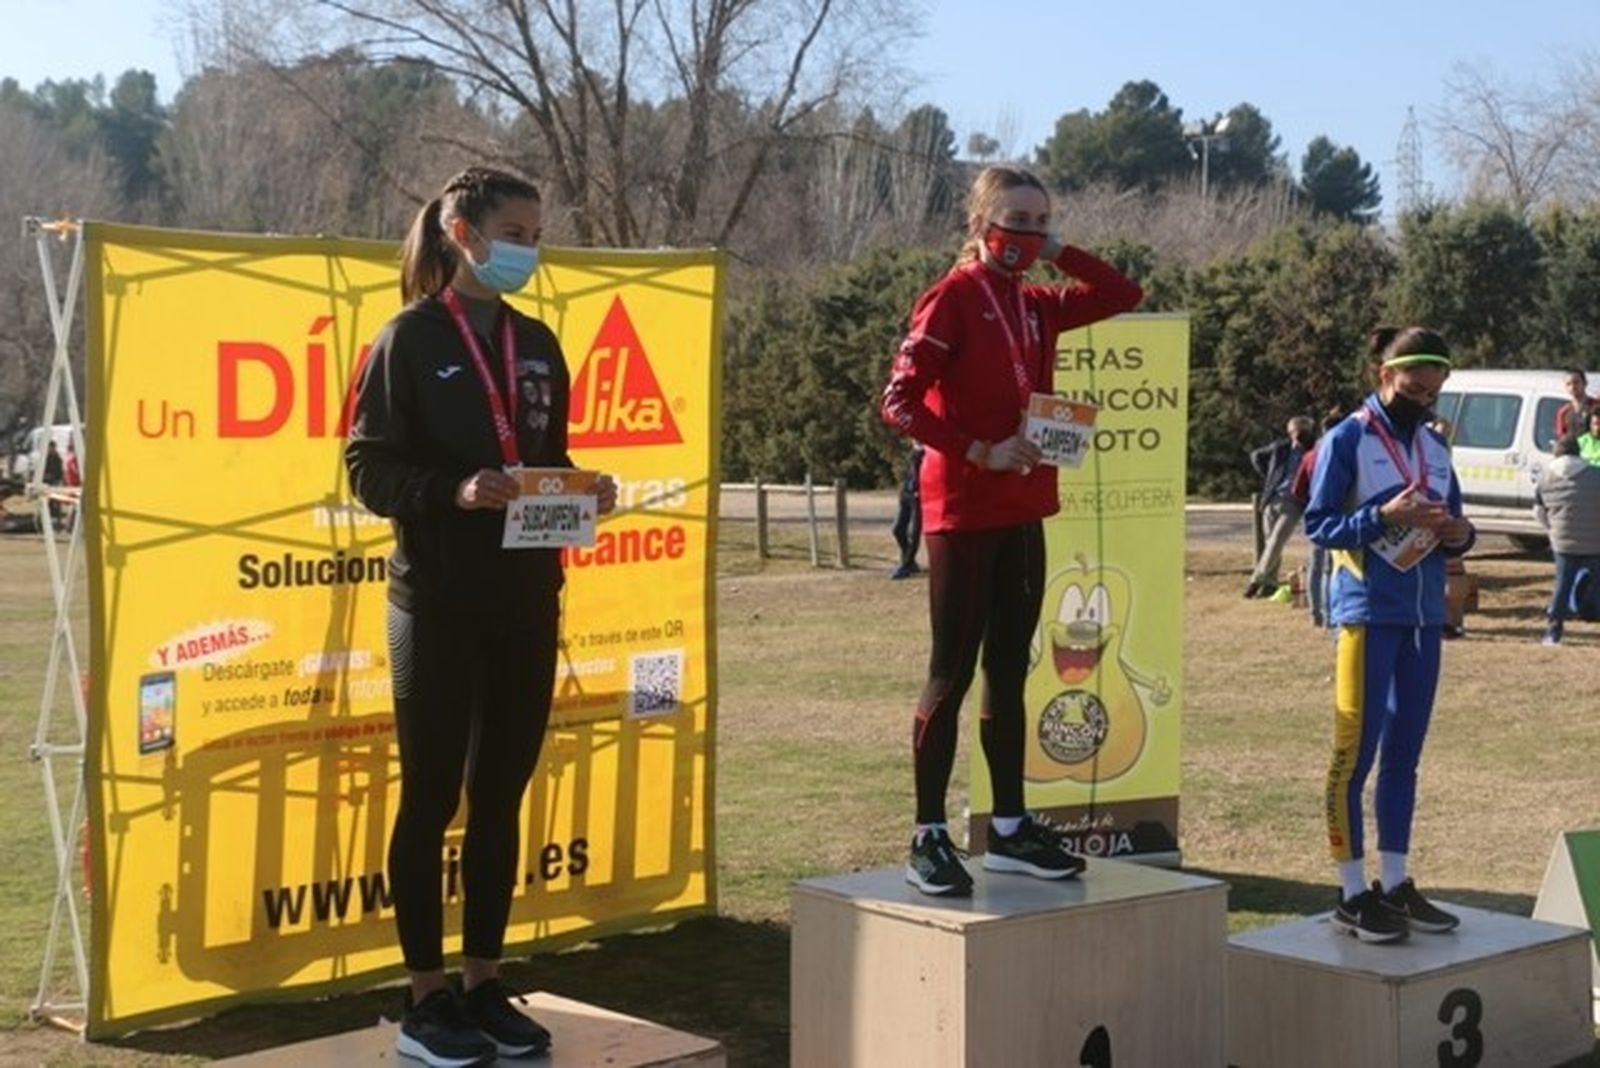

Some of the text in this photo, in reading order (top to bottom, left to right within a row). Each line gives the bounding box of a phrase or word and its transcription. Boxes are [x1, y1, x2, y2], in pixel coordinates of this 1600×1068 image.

[567, 347, 664, 434] Sika
[138, 400, 194, 438] Un
[664, 619, 684, 638] QR
[157, 647, 168, 666] Y
[203, 658, 294, 681] Descárgate
[202, 700, 211, 718] y
[214, 694, 265, 712] accede
[269, 694, 279, 709] a
[284, 684, 322, 706] toda
[1437, 988, 1484, 1068] 3
